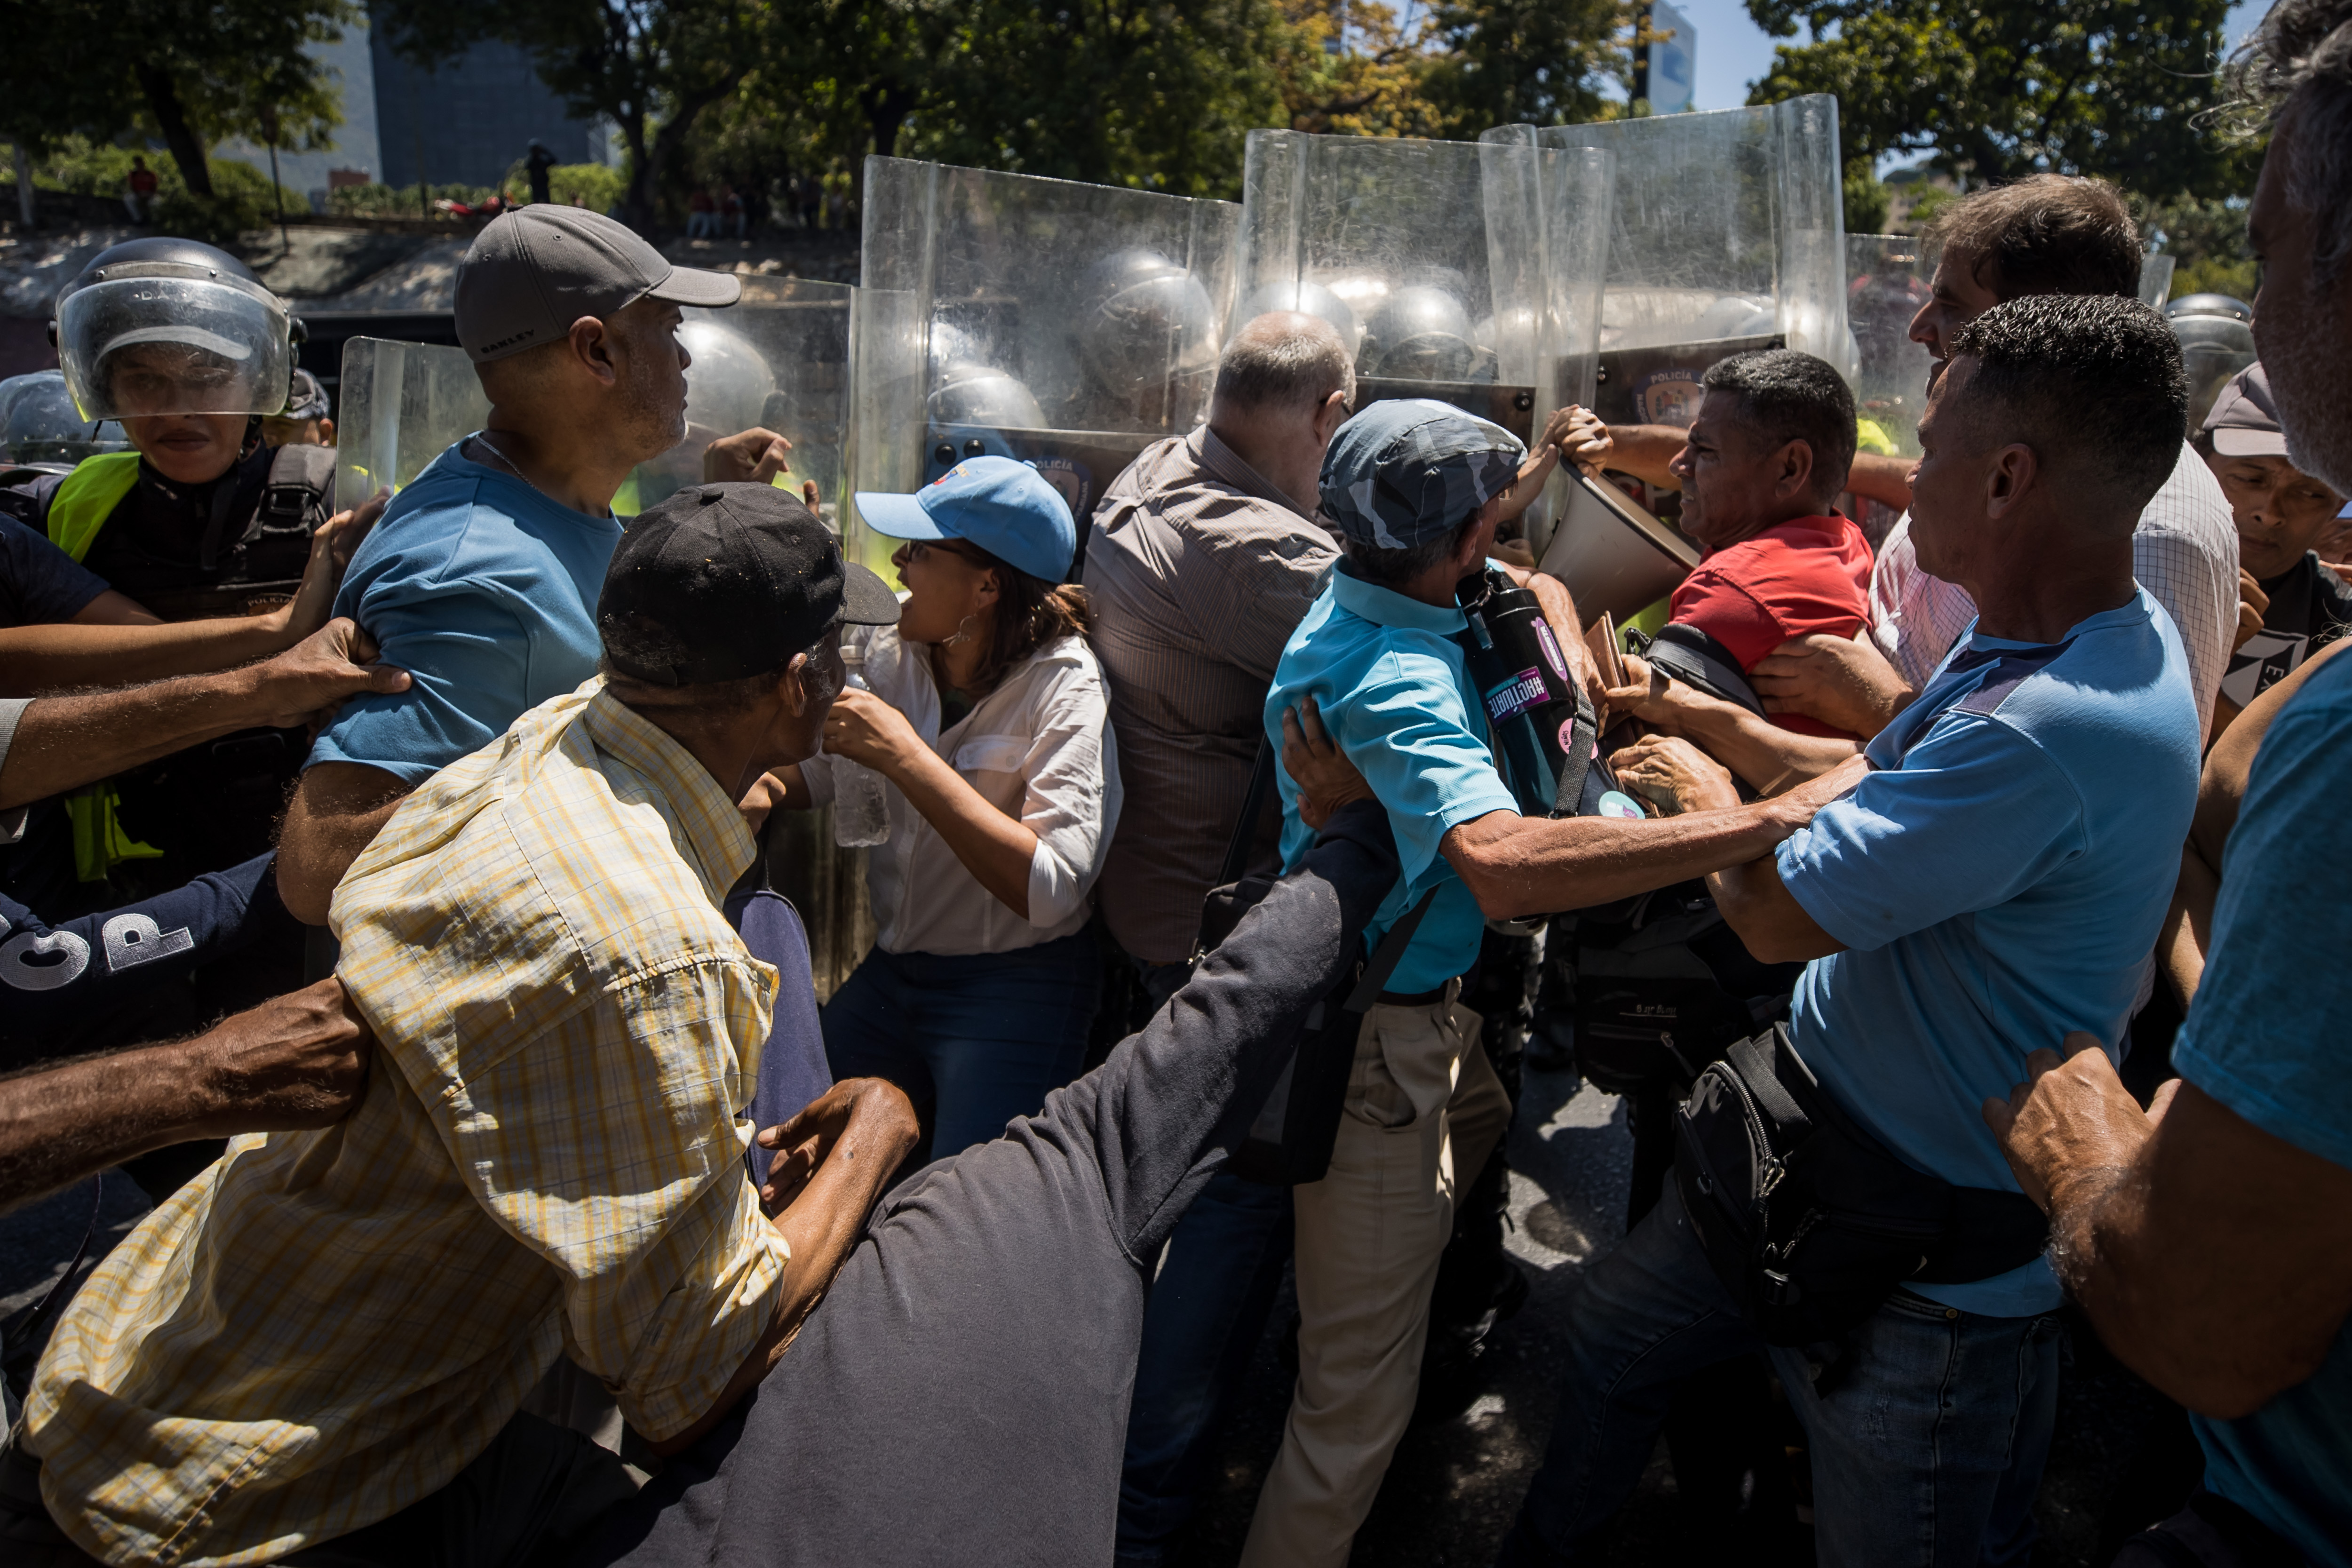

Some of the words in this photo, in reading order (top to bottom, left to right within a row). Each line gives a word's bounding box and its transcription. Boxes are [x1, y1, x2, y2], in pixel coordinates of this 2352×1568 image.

[481, 329, 534, 353] OAKLEY
[1651, 369, 1692, 384] POLICÍA
[1036, 458, 1073, 471] OLICÍA
